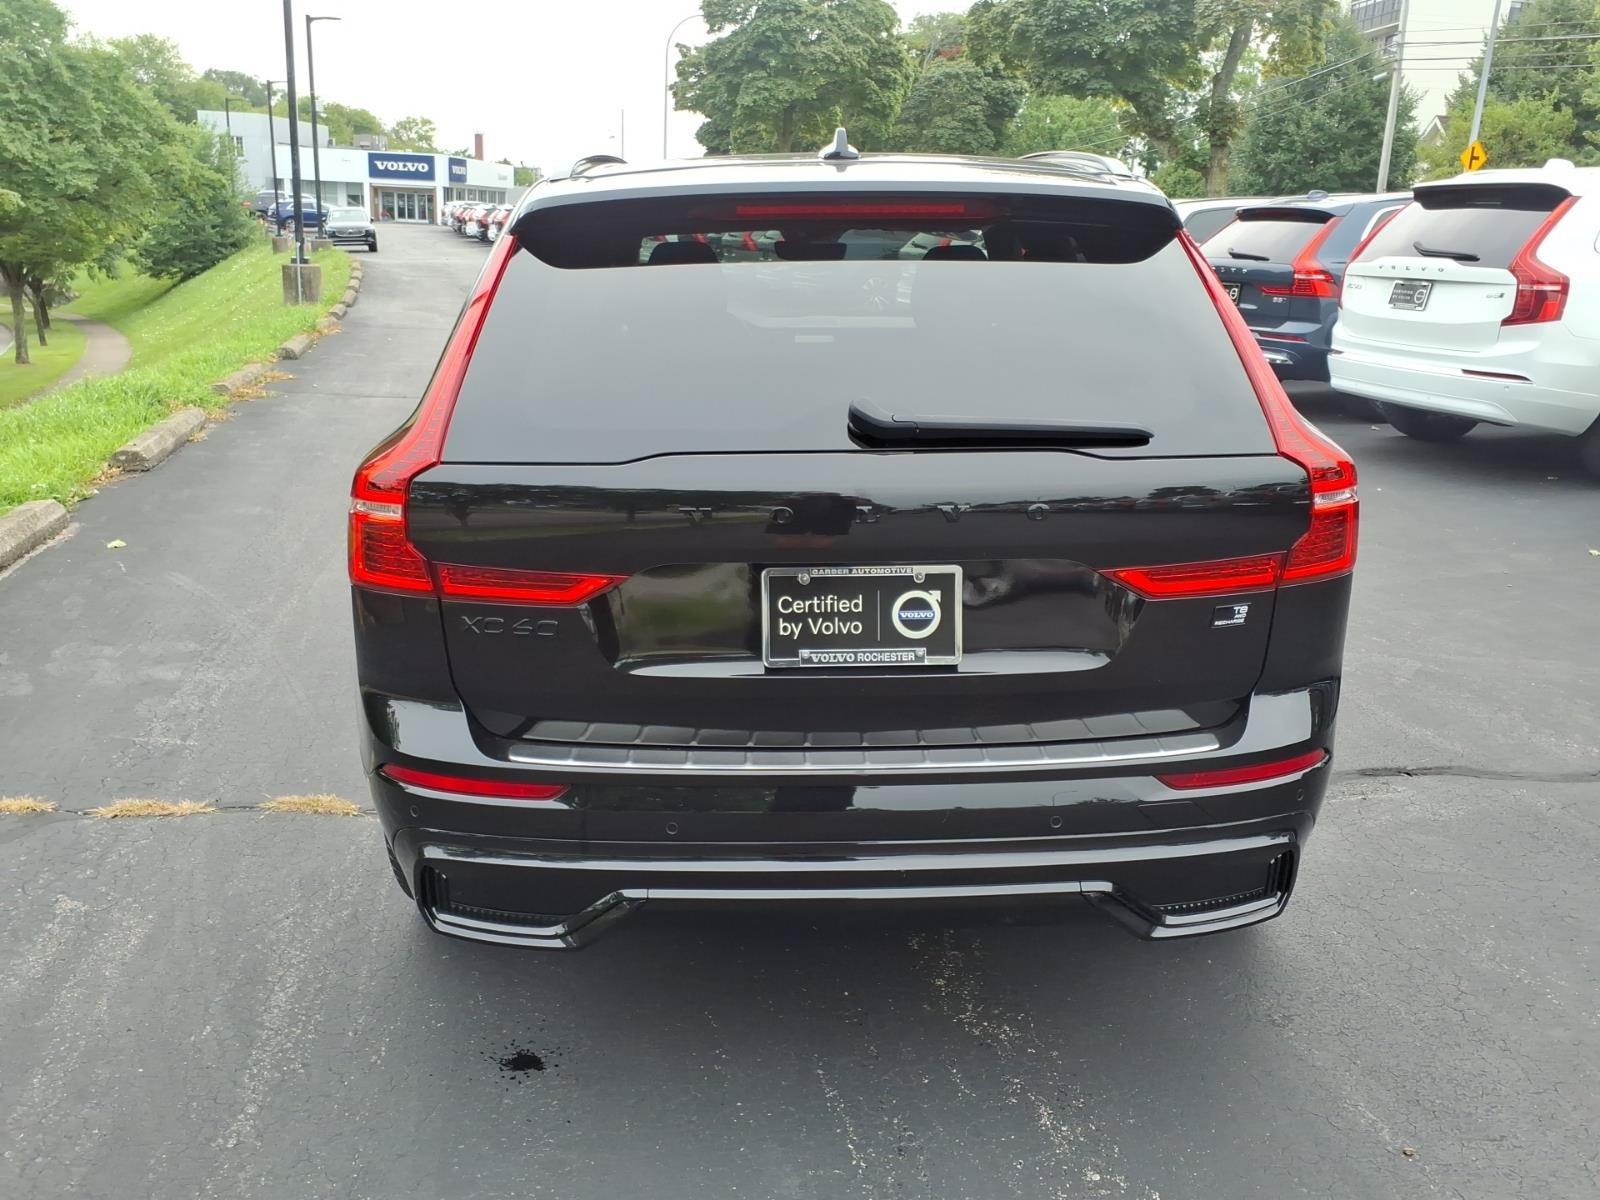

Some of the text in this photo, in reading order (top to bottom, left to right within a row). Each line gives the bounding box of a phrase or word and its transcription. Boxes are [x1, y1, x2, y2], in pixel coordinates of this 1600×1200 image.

[374, 160, 429, 173] VOLVO
[678, 503, 1051, 525] VOLVO
[778, 594, 863, 614] Certified
[1233, 605, 1249, 614] T8
[900, 611, 935, 619] VOLVO
[460, 615, 559, 636] XC60
[779, 617, 863, 640] by Volvo
[810, 651, 916, 663] VOLVO ROCHESTER
